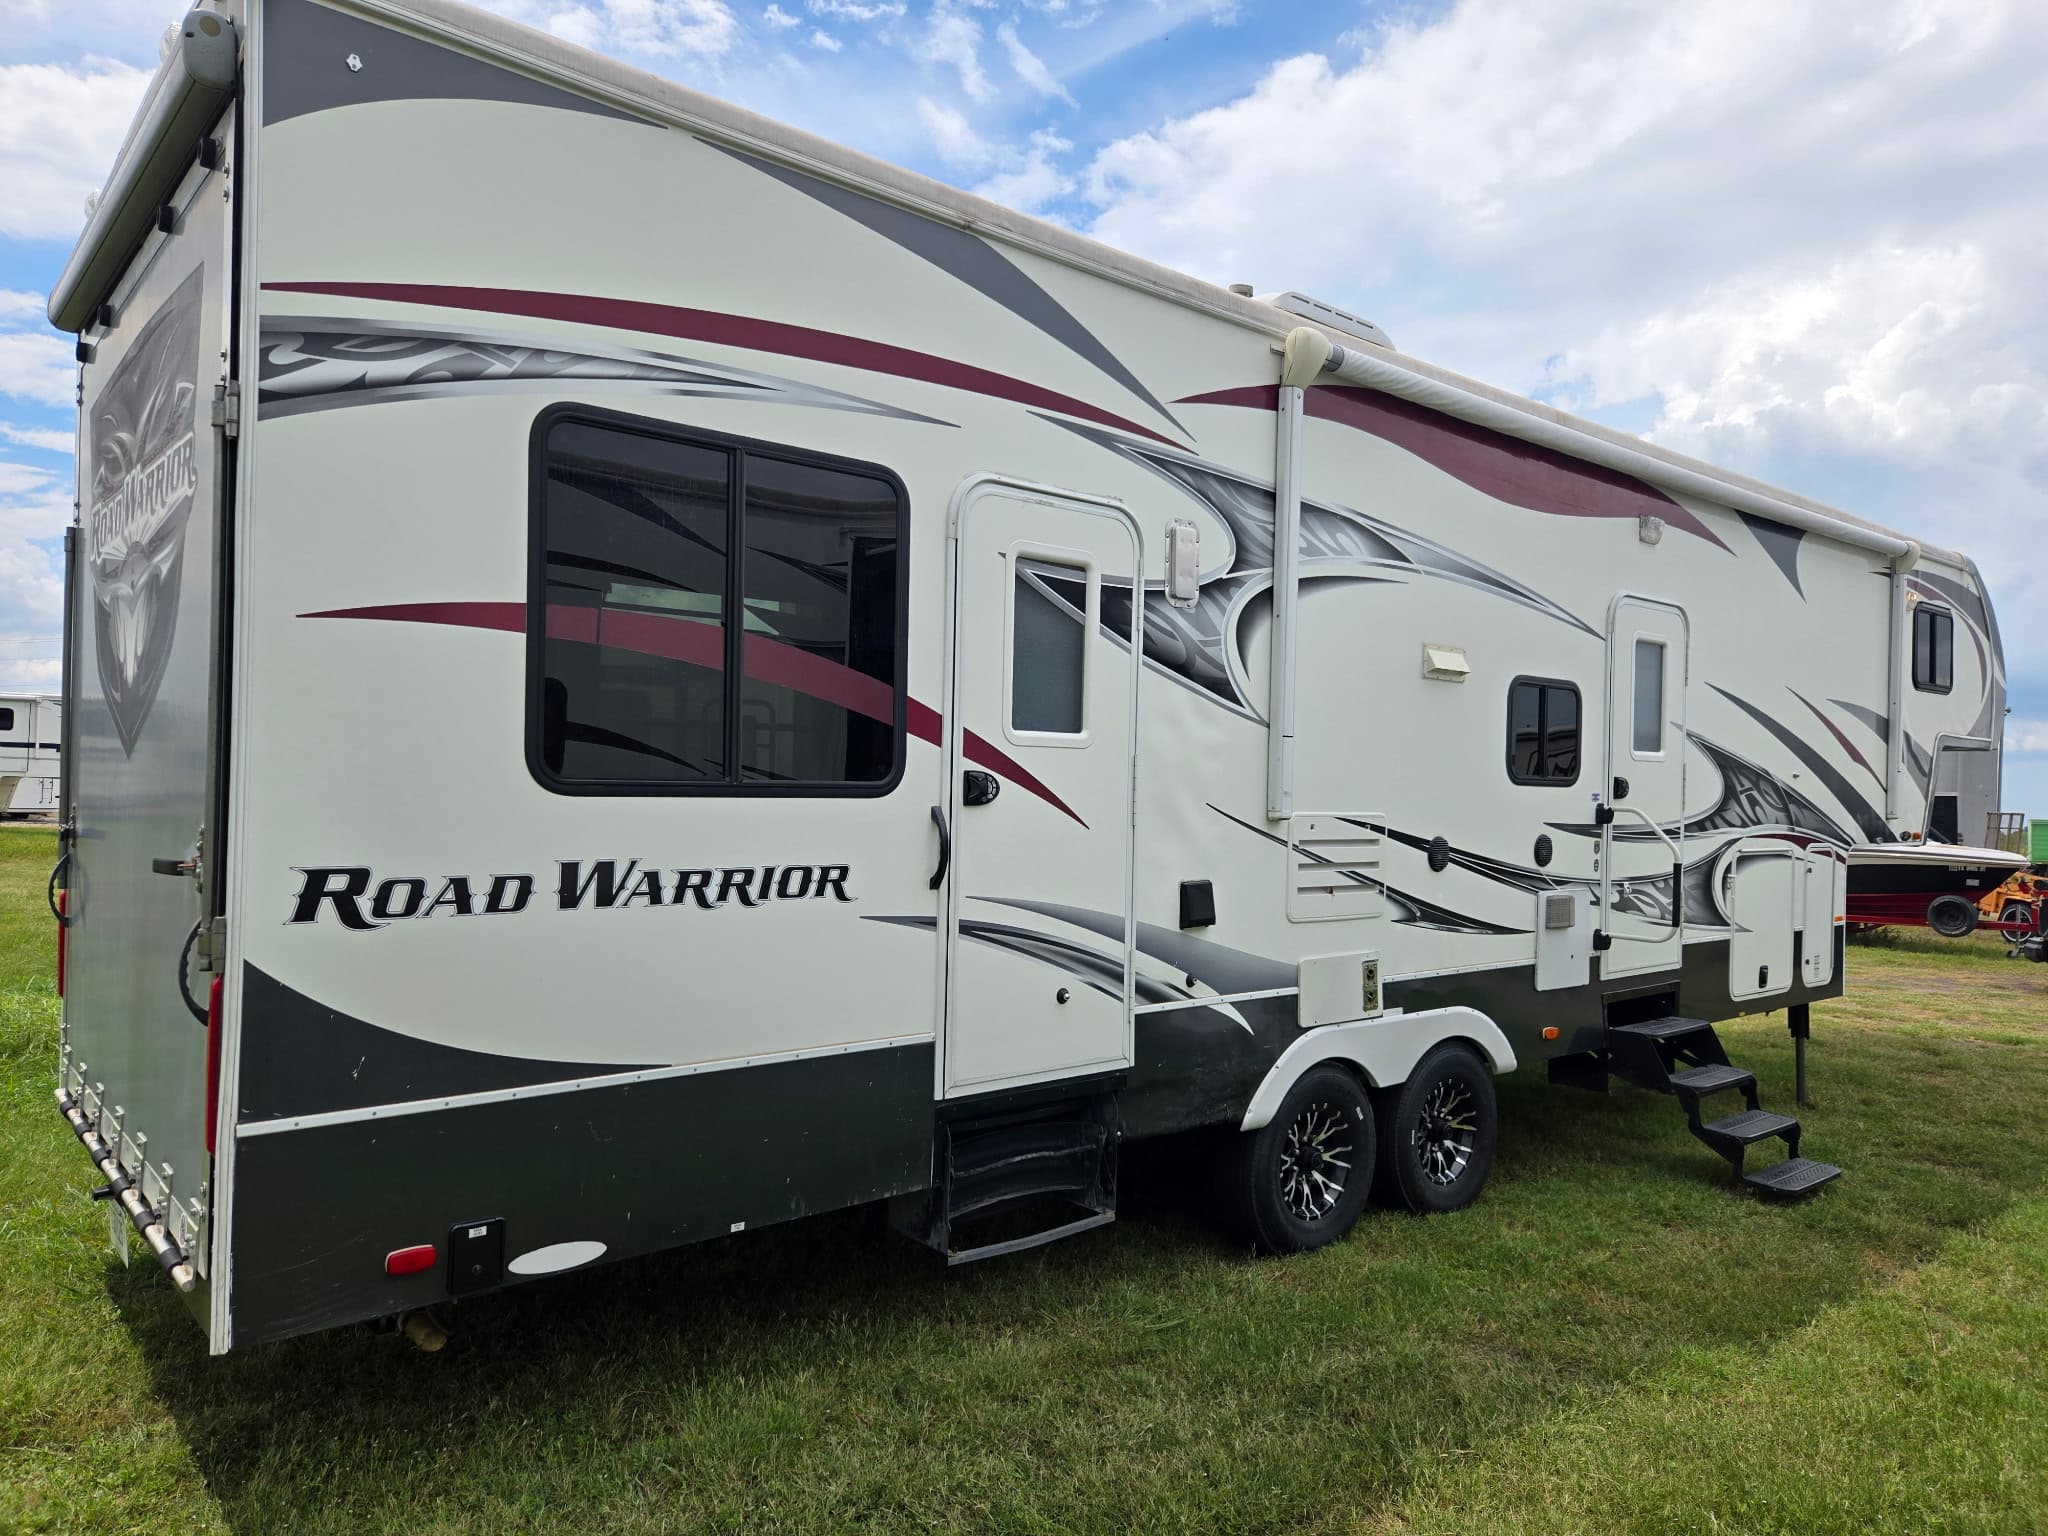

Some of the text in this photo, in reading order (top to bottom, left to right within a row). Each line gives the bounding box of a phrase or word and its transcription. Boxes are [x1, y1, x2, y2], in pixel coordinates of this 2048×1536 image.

[90, 431, 197, 565] ROAD WARRIOR
[282, 857, 858, 931] ROAD WARRIOR
